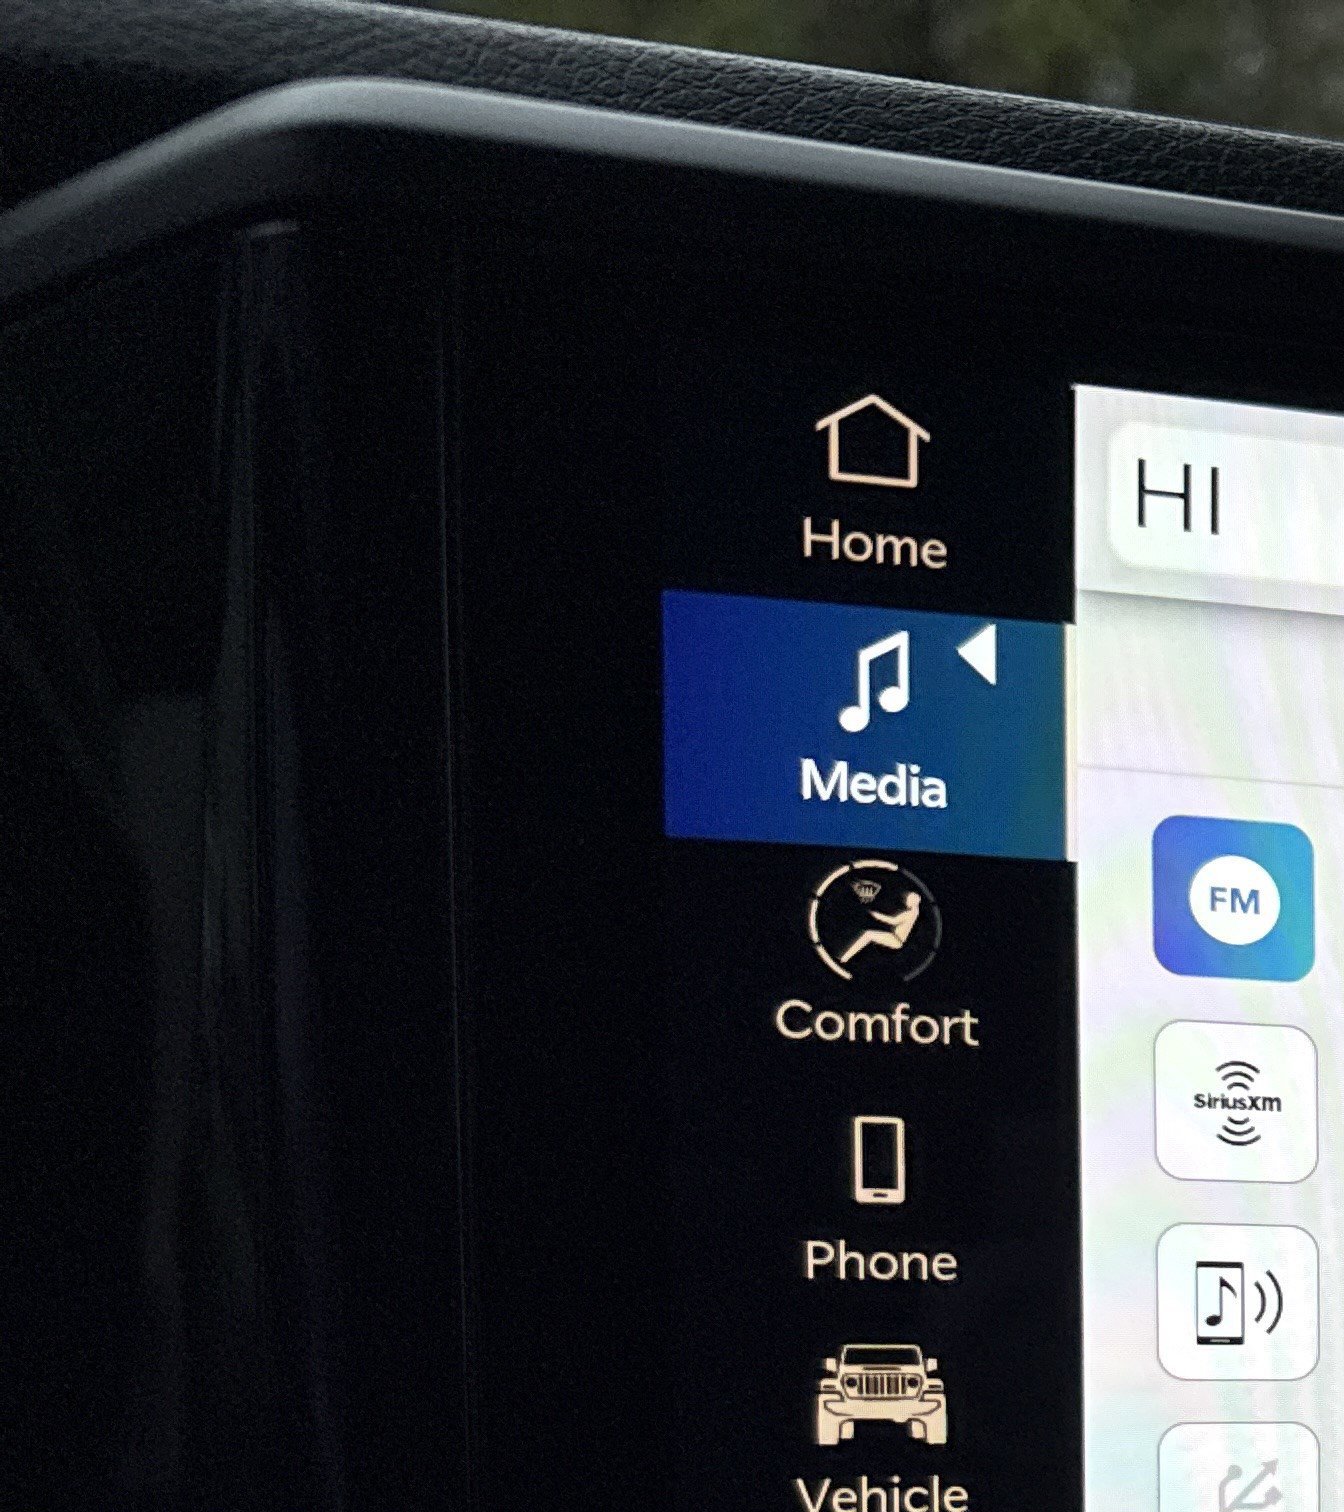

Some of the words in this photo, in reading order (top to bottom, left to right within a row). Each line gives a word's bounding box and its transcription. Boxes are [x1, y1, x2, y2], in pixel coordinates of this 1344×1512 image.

[1137, 458, 1219, 535] HI
[802, 516, 948, 569] Home
[800, 758, 948, 809] Media
[1209, 885, 1261, 916] FM
[775, 997, 980, 1047] Comfort
[805, 1239, 959, 1282] Phone
